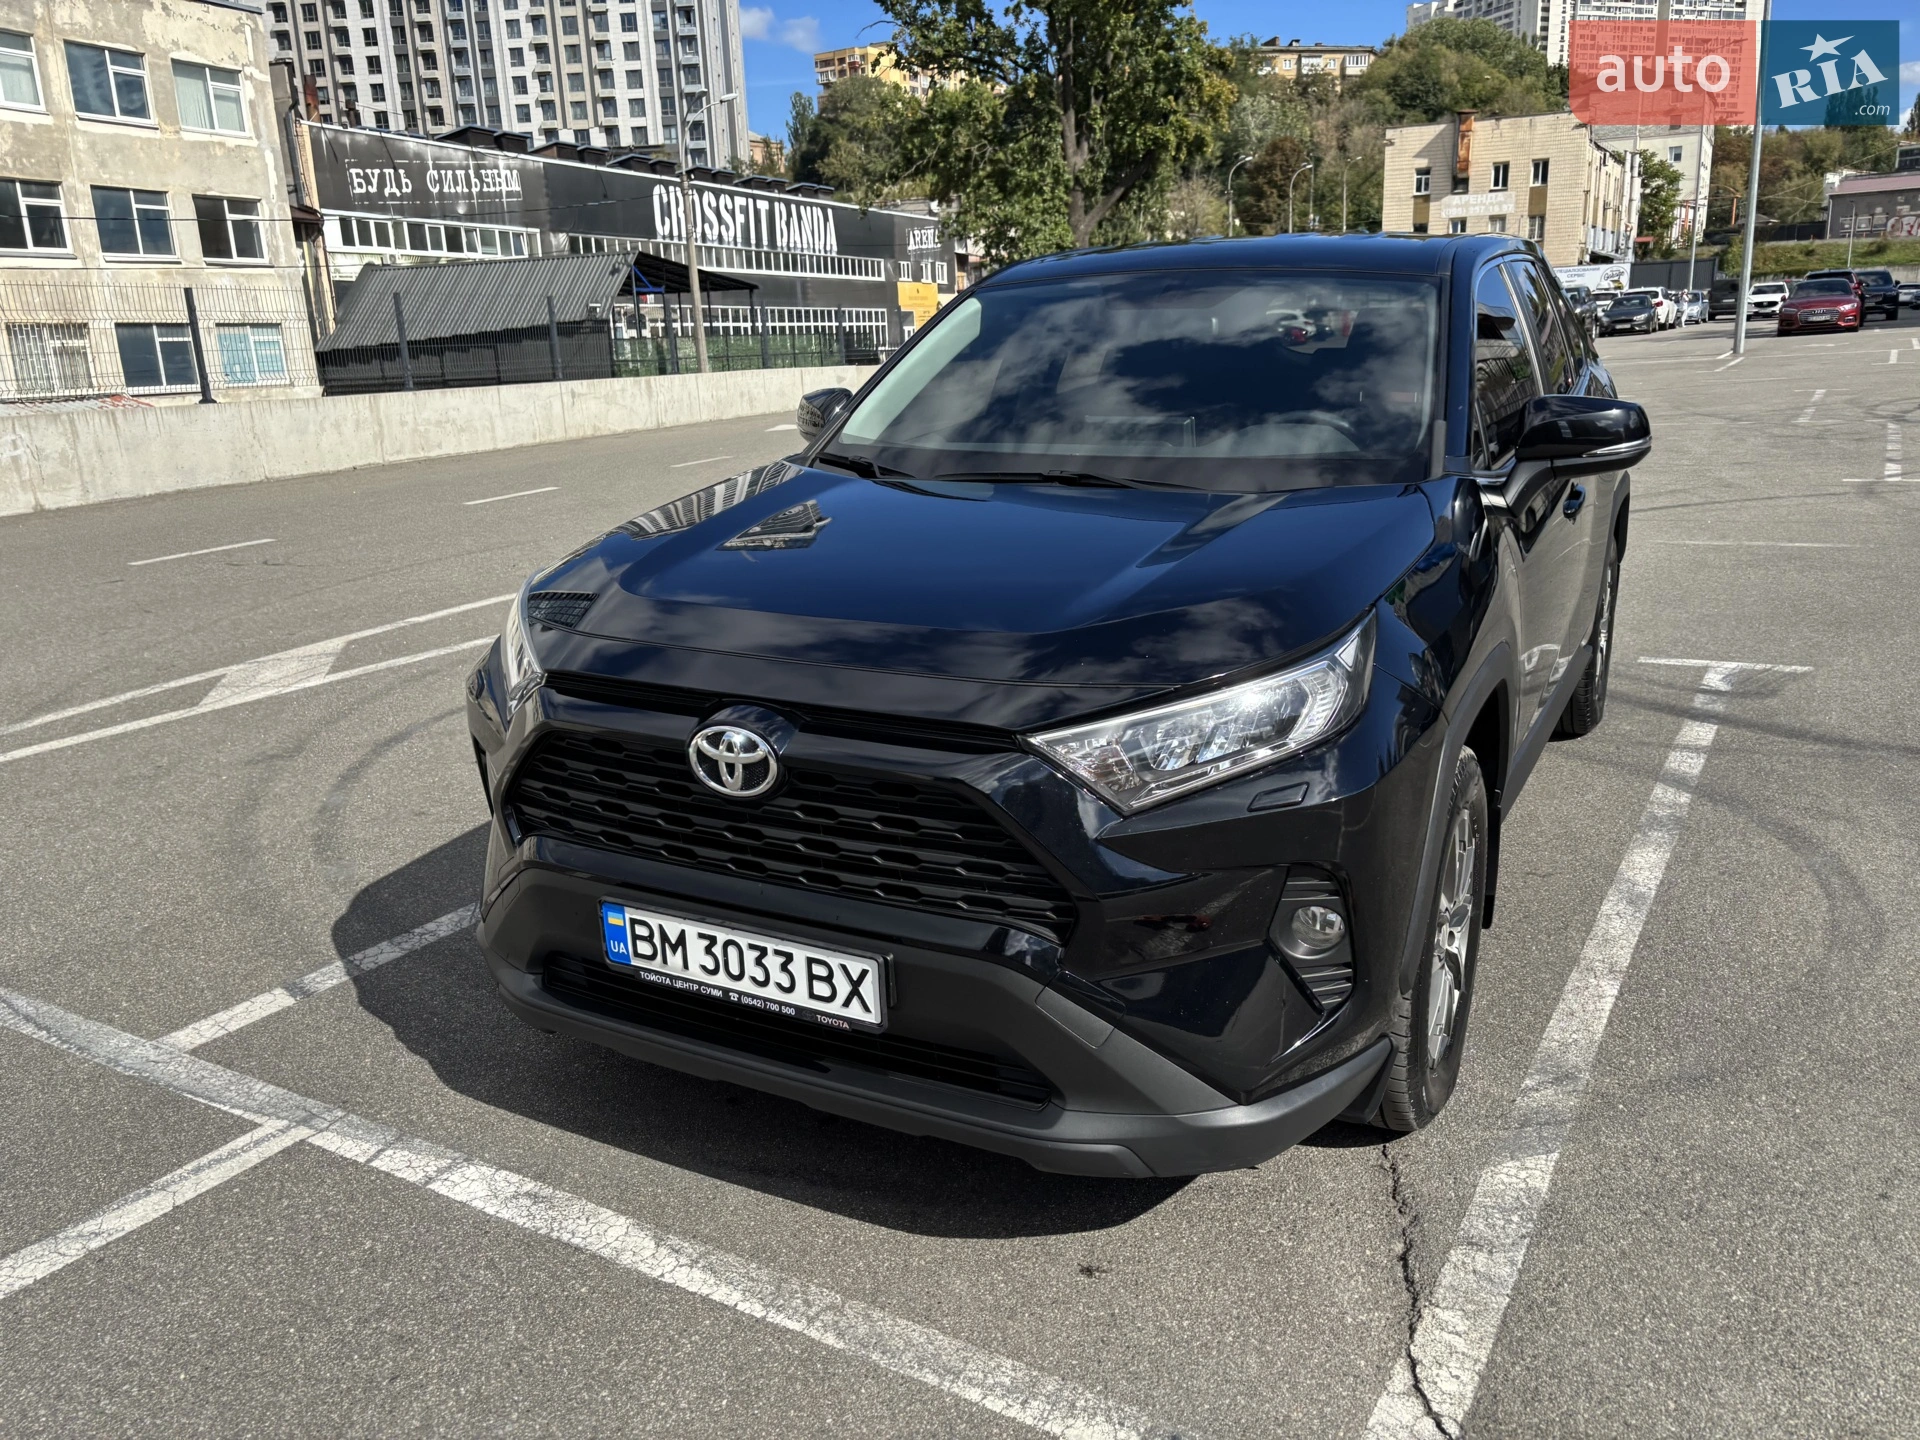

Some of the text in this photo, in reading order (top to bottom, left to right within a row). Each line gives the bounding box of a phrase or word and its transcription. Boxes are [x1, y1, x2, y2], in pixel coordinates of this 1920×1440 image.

[349, 168, 413, 198] БУДЬ
[1453, 194, 1505, 205] АРЕНДА
[652, 183, 838, 253] CROSSFIT BANDA
[609, 939, 628, 955] UA
[628, 916, 873, 1014] BM 3033 BX
[640, 970, 723, 998] ТОЙОТА ЦЕНТР СУМИ
[740, 994, 850, 1029] (0542) 700 500 TOYOTA
